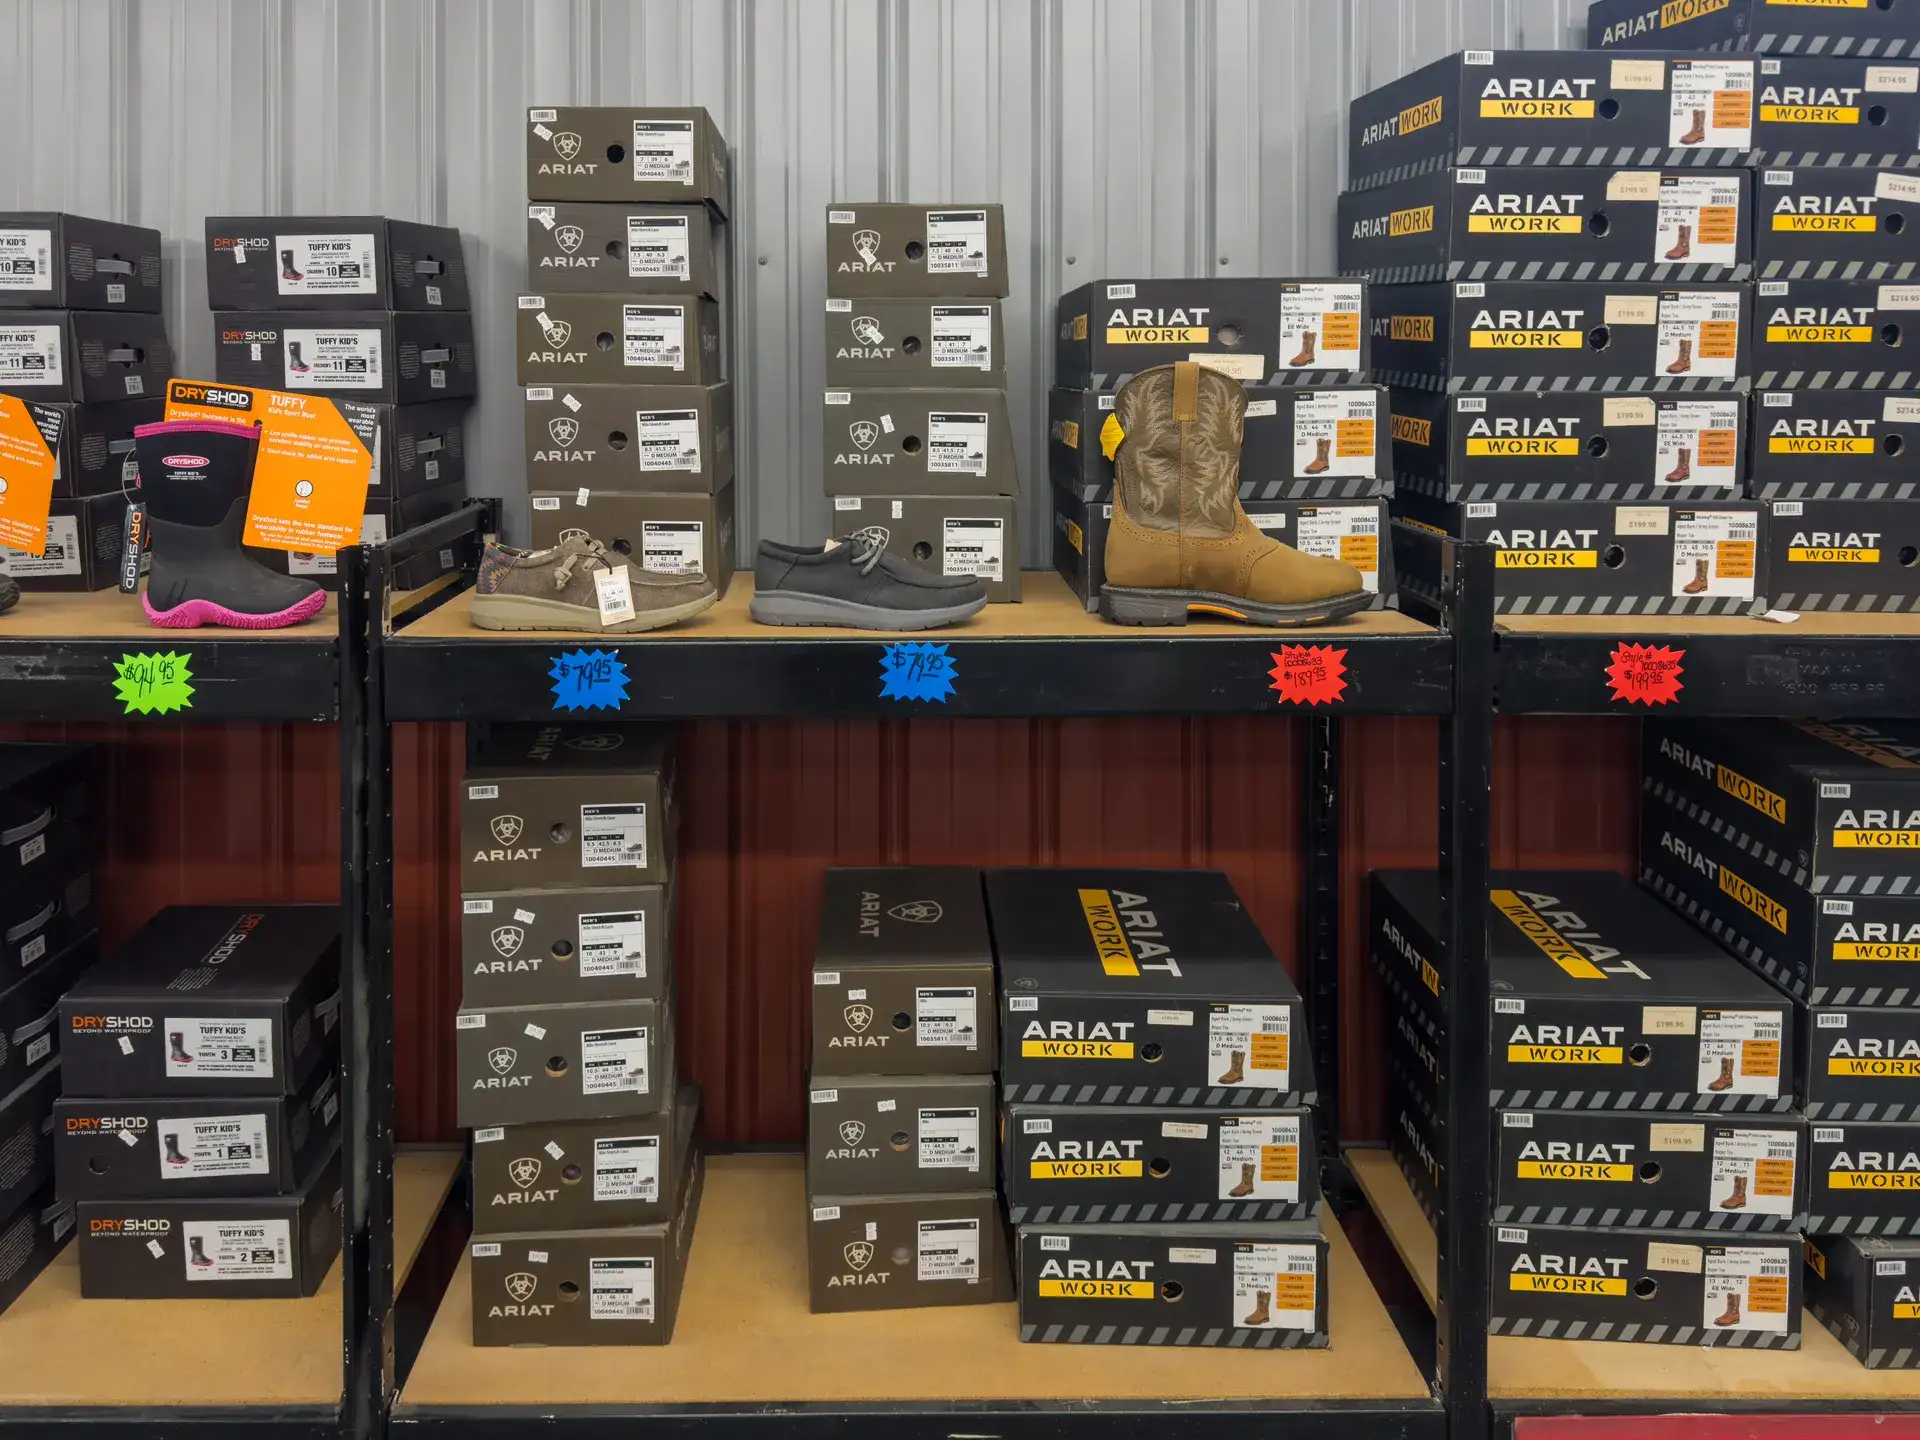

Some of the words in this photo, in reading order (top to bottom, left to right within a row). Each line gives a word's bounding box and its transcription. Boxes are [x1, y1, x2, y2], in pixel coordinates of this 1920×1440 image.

[1601, 11, 1659, 46] ARIAT
[1481, 78, 1596, 98] ARIAT
[1760, 86, 1861, 106] ARIAT
[1401, 99, 1440, 132] WORK
[1501, 103, 1572, 115] WORK
[1776, 108, 1839, 121] WORK
[1362, 117, 1398, 146] ARIAT
[538, 164, 598, 174] ARIAT
[1888, 183, 1917, 193] $214.95
[1469, 194, 1584, 214] ARIAT
[1773, 196, 1857, 214] ARIAT
[1489, 218, 1560, 231] WORK
[1792, 217, 1856, 229] WORK
[8, 238, 26, 246] KID'S
[214, 237, 269, 247] DRYSHOD
[332, 242, 351, 250] KID'S
[540, 256, 600, 267] ARIAT
[838, 261, 896, 272] ARIAT
[1107, 308, 1210, 326] ARIAT
[1471, 310, 1584, 329] ARIAT
[1768, 307, 1874, 325] ARIAT
[1126, 329, 1190, 341] WORK
[1394, 318, 1432, 340] WORK
[1787, 328, 1852, 340] WORK
[15, 334, 35, 342] KID'S
[222, 331, 277, 341] DRYSHOD
[339, 337, 358, 345] KID'S
[1491, 333, 1561, 346] WORK
[527, 352, 588, 363] ARIAT
[333, 360, 343, 370] 11
[175, 386, 248, 404] DRYSHOD
[271, 395, 307, 409] TUFFY
[284, 409, 300, 418] Sport
[357, 405, 376, 414] world's
[348, 417, 374, 426] wearable
[1467, 418, 1580, 436] ARIAT
[1487, 441, 1557, 453] WORK
[533, 450, 596, 461] ARIAT
[834, 454, 895, 464] ARIAT
[252, 515, 278, 524] Dryshod
[317, 523, 343, 532] standard
[1485, 530, 1598, 548] ARIAT
[1789, 532, 1881, 548] ARIAT
[130, 511, 143, 590] DRYSHOD
[1805, 550, 1862, 560] WORK
[1503, 553, 1576, 565] WORK
[1660, 738, 1715, 780] ARIAT
[1721, 770, 1784, 820] WORK
[473, 848, 542, 862] ARIAT
[1660, 831, 1717, 880] ARIAT
[1723, 870, 1785, 930] WORK
[859, 891, 880, 937] ARIAT
[1087, 904, 1128, 959] WORK
[1111, 890, 1183, 978] ARIAT
[1503, 904, 1582, 961] WORK
[1516, 890, 1651, 982] ARIAT
[208, 912, 264, 965] DRYSHOD
[474, 959, 542, 974] ARIAT
[72, 1016, 153, 1028] DRYSHOD
[200, 1026, 224, 1034] TUFFY
[226, 1026, 246, 1034] KID'S
[1022, 1020, 1134, 1040] ARIAT
[1509, 1025, 1624, 1045] ARIAT
[828, 1036, 890, 1047] ARIAT
[221, 1050, 228, 1060] 3
[1043, 1043, 1112, 1056] WORK
[1535, 1048, 1601, 1061] WORK
[67, 1117, 148, 1129] DRYSHOD
[194, 1126, 218, 1134] TUFFY
[220, 1125, 241, 1133] KID'S
[825, 1148, 880, 1159] ARIAT
[491, 1189, 559, 1206] ARIAT
[90, 1219, 171, 1231] DRYSHOD
[218, 1230, 243, 1238] TUFFY
[244, 1229, 264, 1237] KID'S
[1511, 1253, 1628, 1277] ARIAT
[1661, 1257, 1689, 1265] $199.95
[1039, 1259, 1154, 1280] ARIAT
[827, 1272, 890, 1287] ARIAT
[1532, 1277, 1605, 1292] WORK
[1060, 1282, 1132, 1296] WORK
[488, 1305, 555, 1317] ARIAT
